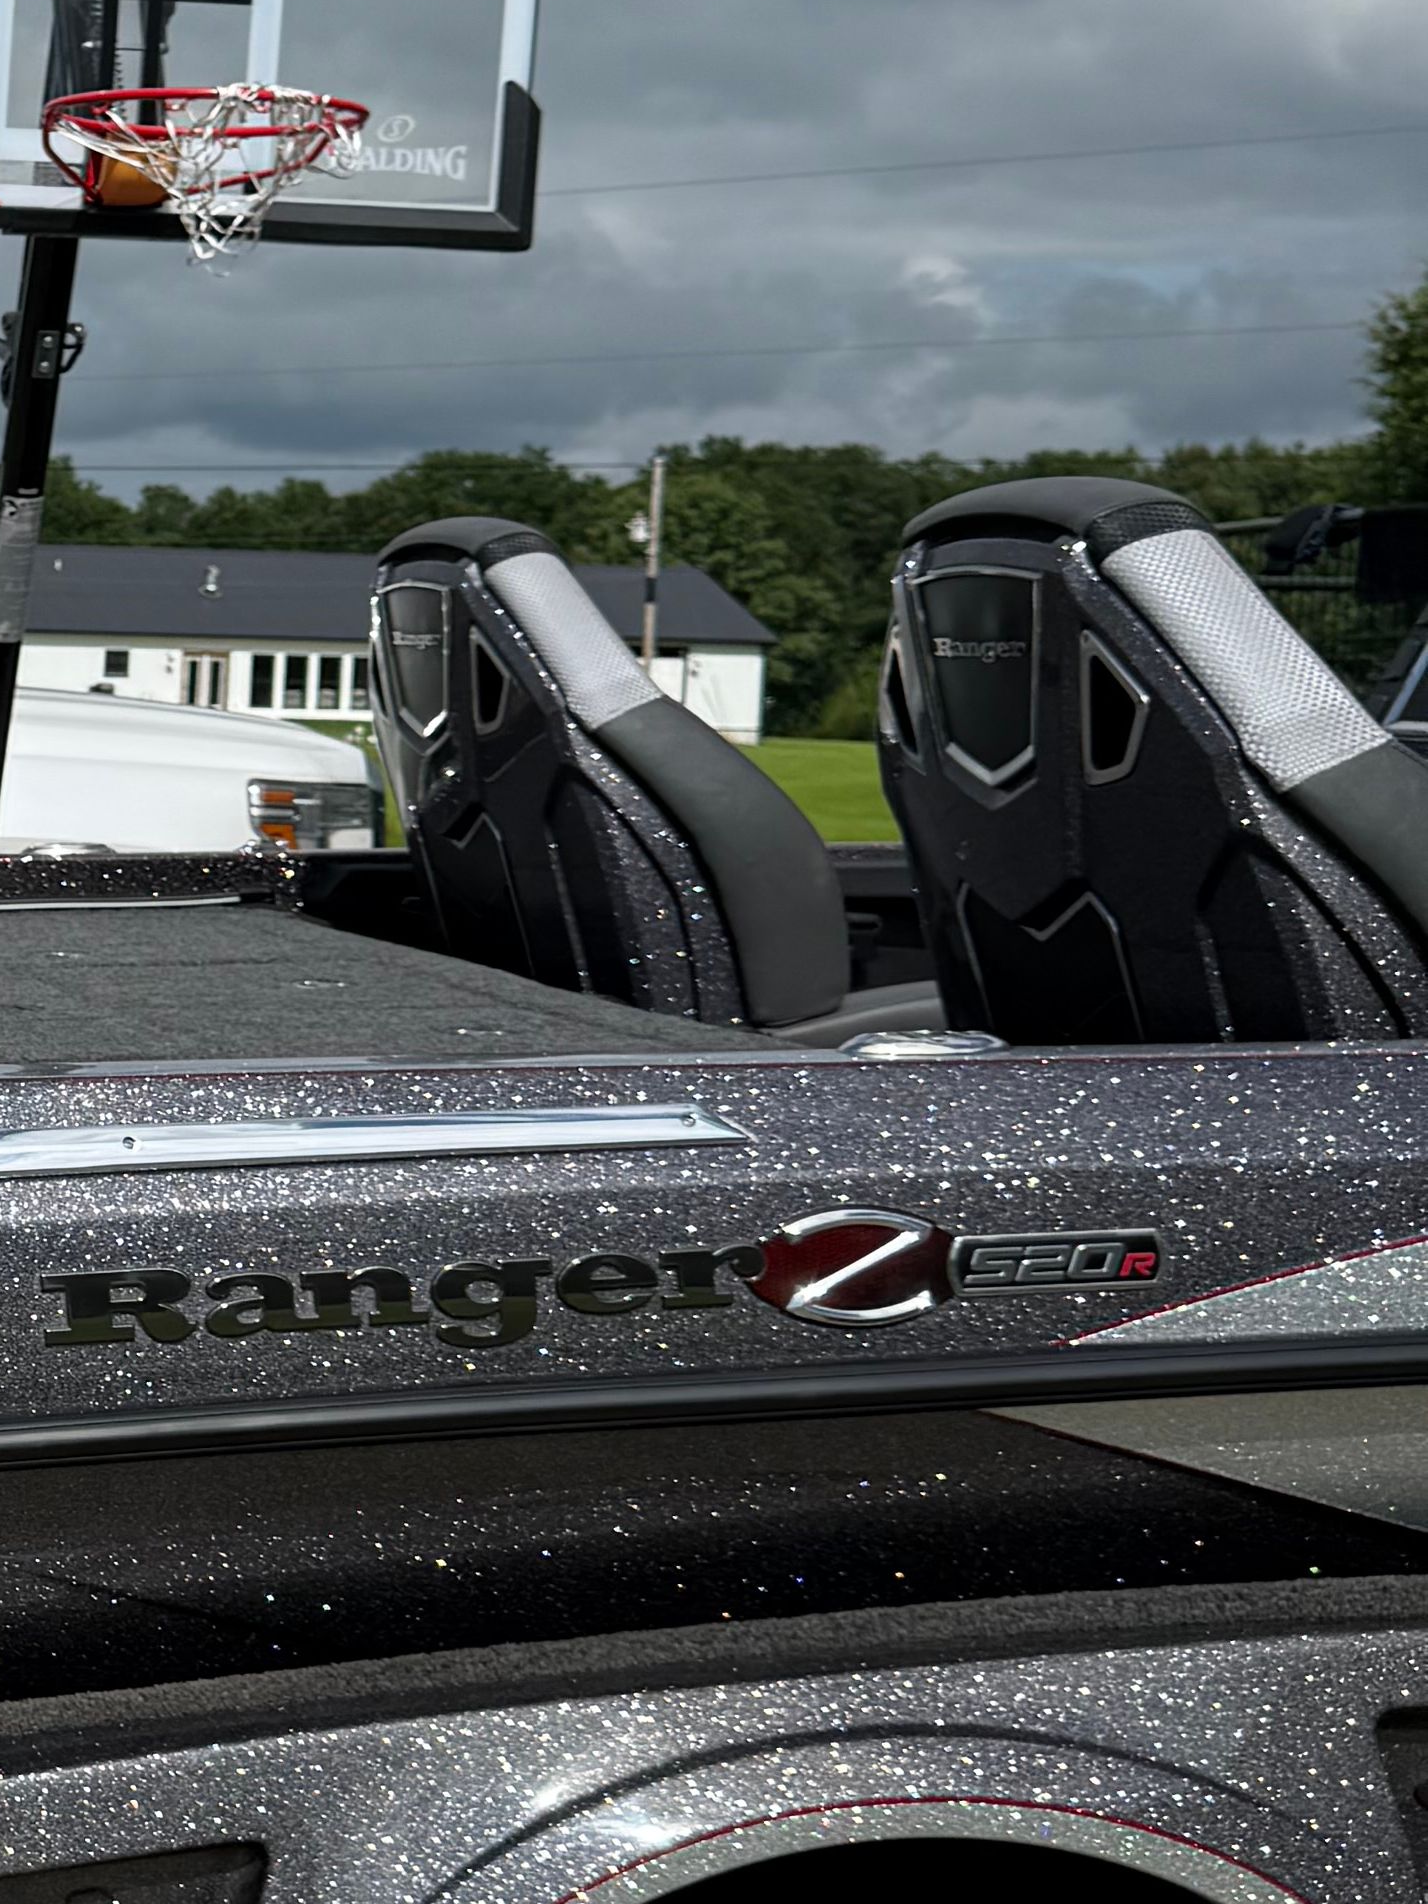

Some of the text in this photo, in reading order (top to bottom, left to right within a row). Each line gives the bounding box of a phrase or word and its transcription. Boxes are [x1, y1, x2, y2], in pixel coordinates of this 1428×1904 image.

[334, 145, 468, 181] ALDING
[932, 637, 1026, 663] Ranger
[40, 1244, 768, 1348] Ranger
